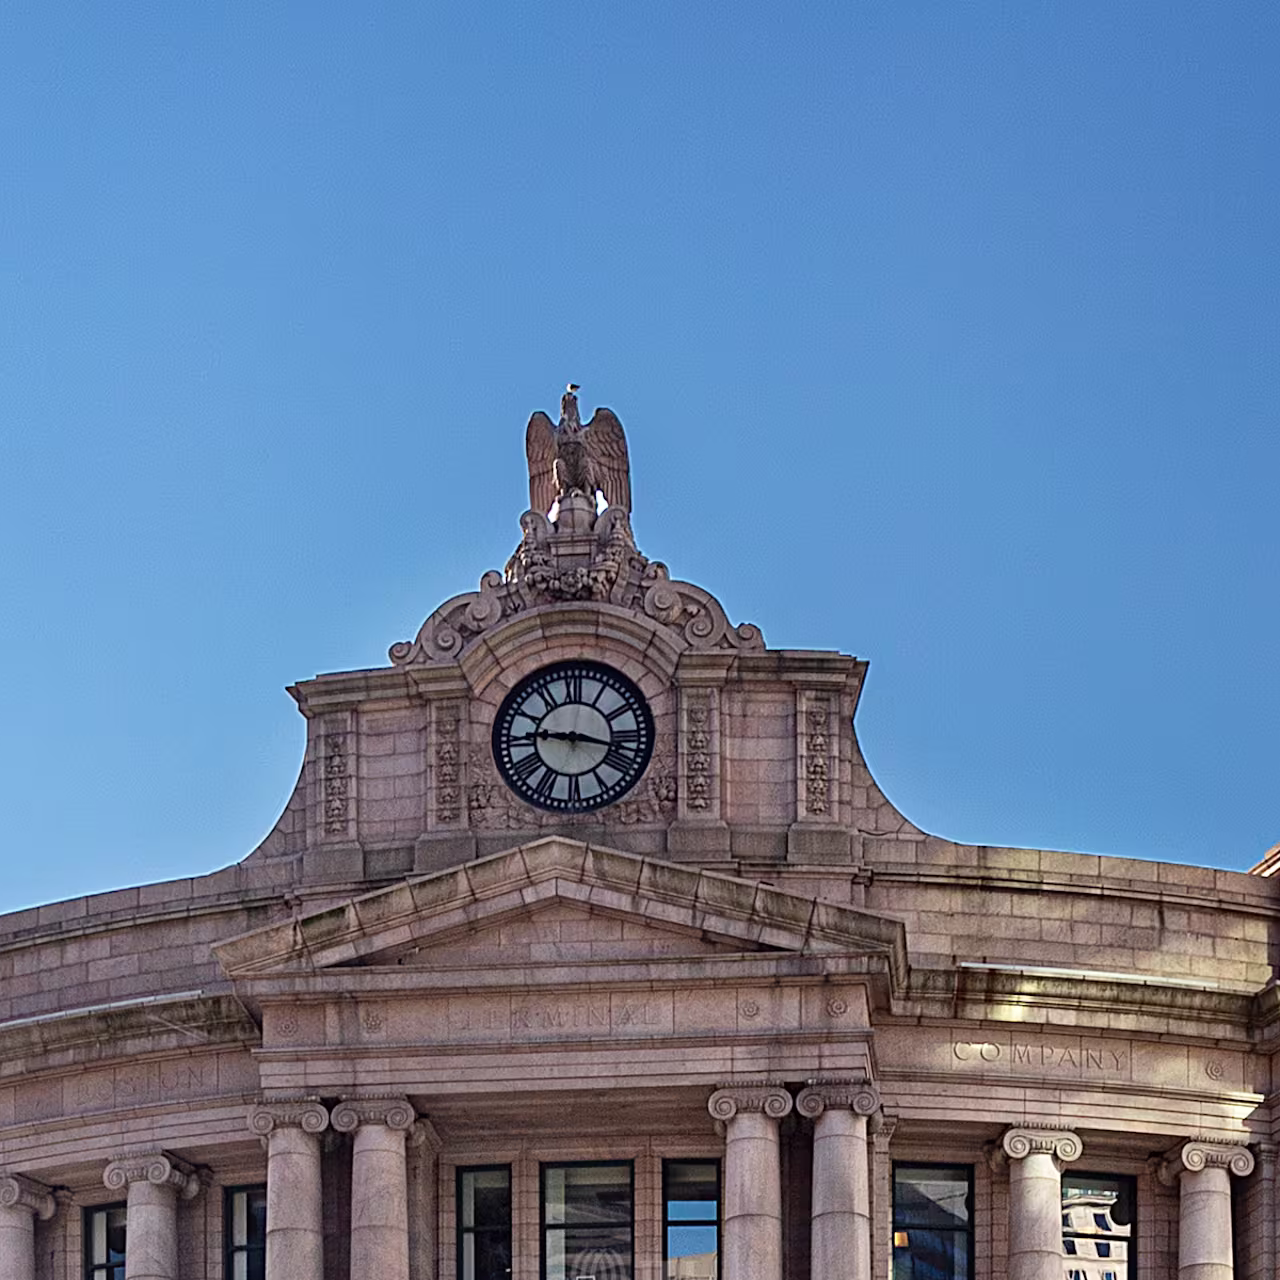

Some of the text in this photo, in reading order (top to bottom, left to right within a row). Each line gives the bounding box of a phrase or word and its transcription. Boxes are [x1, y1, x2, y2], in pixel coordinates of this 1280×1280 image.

[456, 1001, 660, 1031] TERMINAL
[952, 1040, 1127, 1073] COMPANY
[74, 1065, 206, 1107] BOSTON
